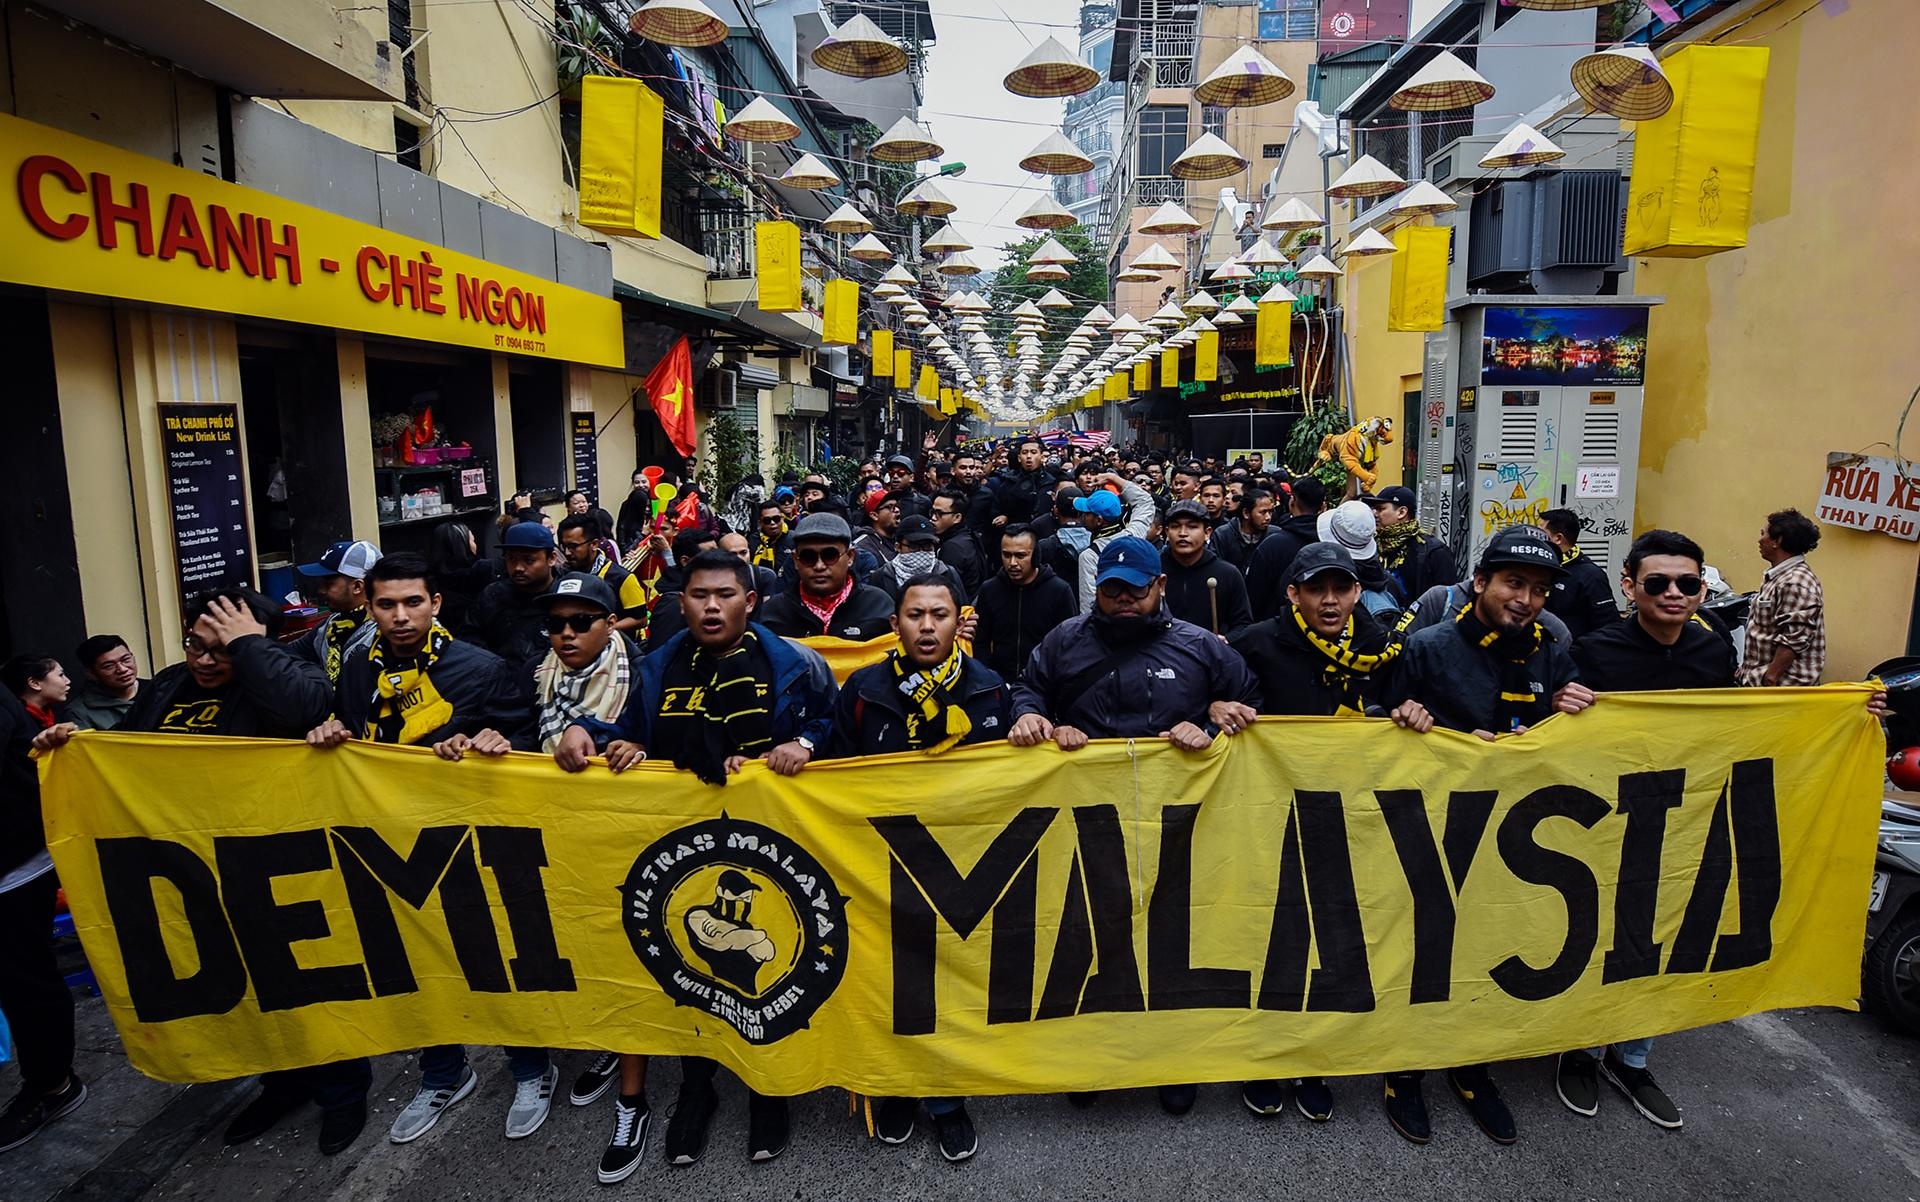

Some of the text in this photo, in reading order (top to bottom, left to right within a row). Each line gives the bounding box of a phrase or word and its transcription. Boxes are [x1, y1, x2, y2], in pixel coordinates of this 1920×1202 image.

[18, 155, 303, 285] CHANH
[357, 245, 446, 315] CHÈ
[457, 273, 547, 334] NGON
[1460, 390, 1475, 401] 420
[182, 417, 208, 429] CHANH
[176, 430, 231, 442] New Drink List
[1820, 505, 1870, 527] THAY
[1511, 545, 1553, 560] RESPECT
[95, 757, 1784, 1036] DEMI MALAYSIA
[672, 970, 711, 999] UNTIL
[762, 985, 805, 1021] REBEL
